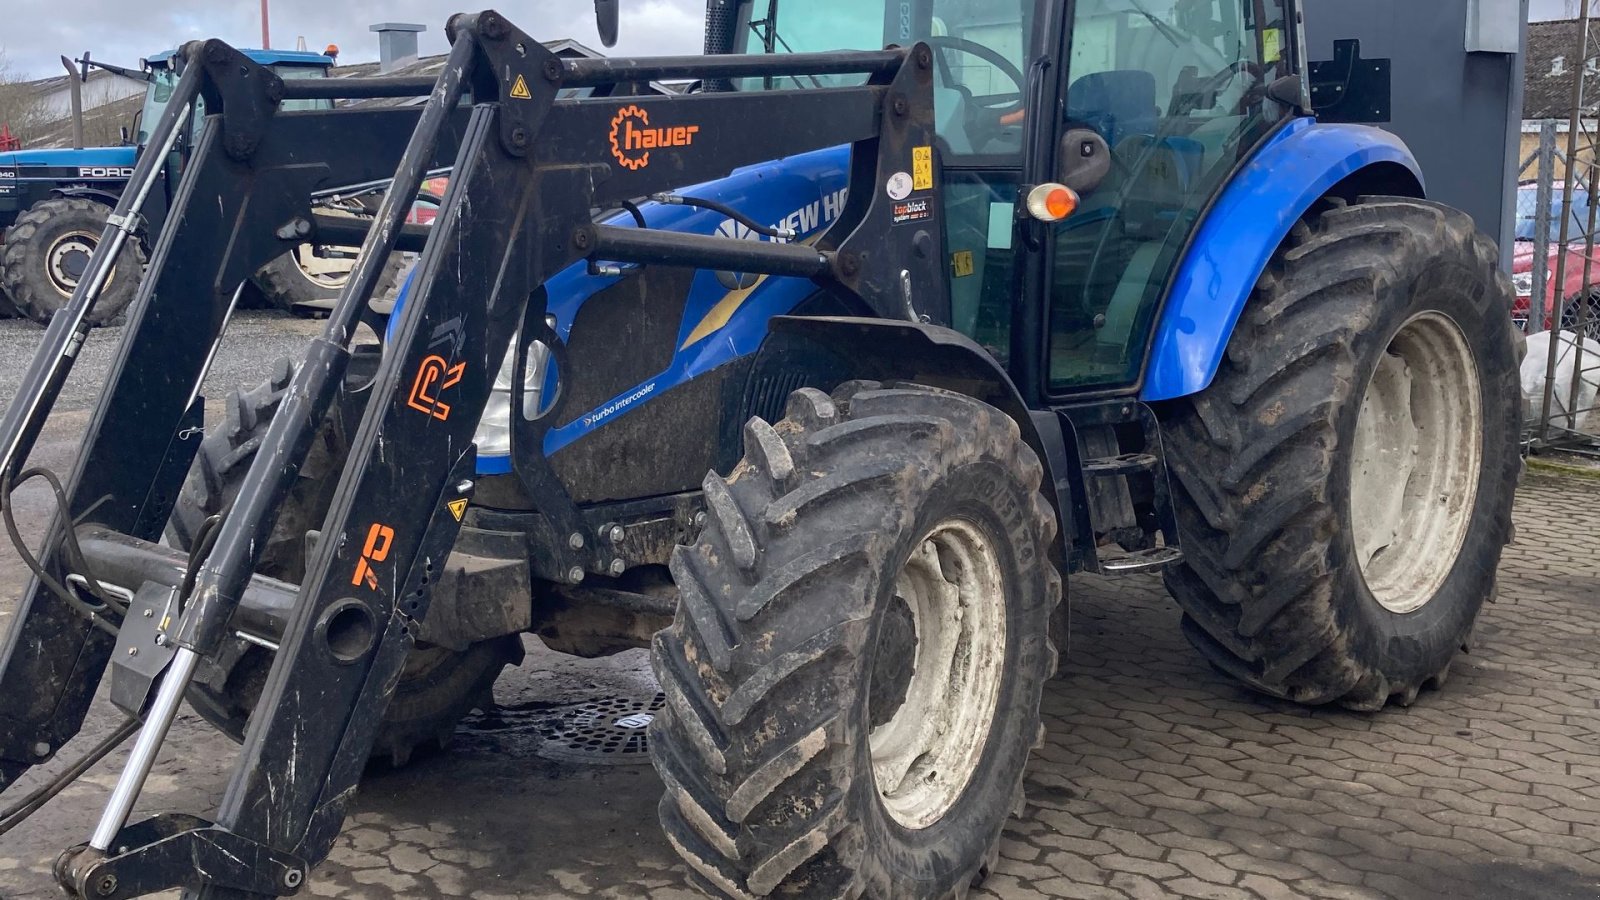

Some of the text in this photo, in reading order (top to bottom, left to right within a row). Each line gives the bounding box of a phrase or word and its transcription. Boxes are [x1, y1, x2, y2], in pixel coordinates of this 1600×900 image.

[625, 121, 699, 150] hauer
[80, 167, 136, 177] FORD
[407, 354, 467, 421] R
[592, 383, 655, 422] turbo intercooler
[351, 522, 395, 591] 70
